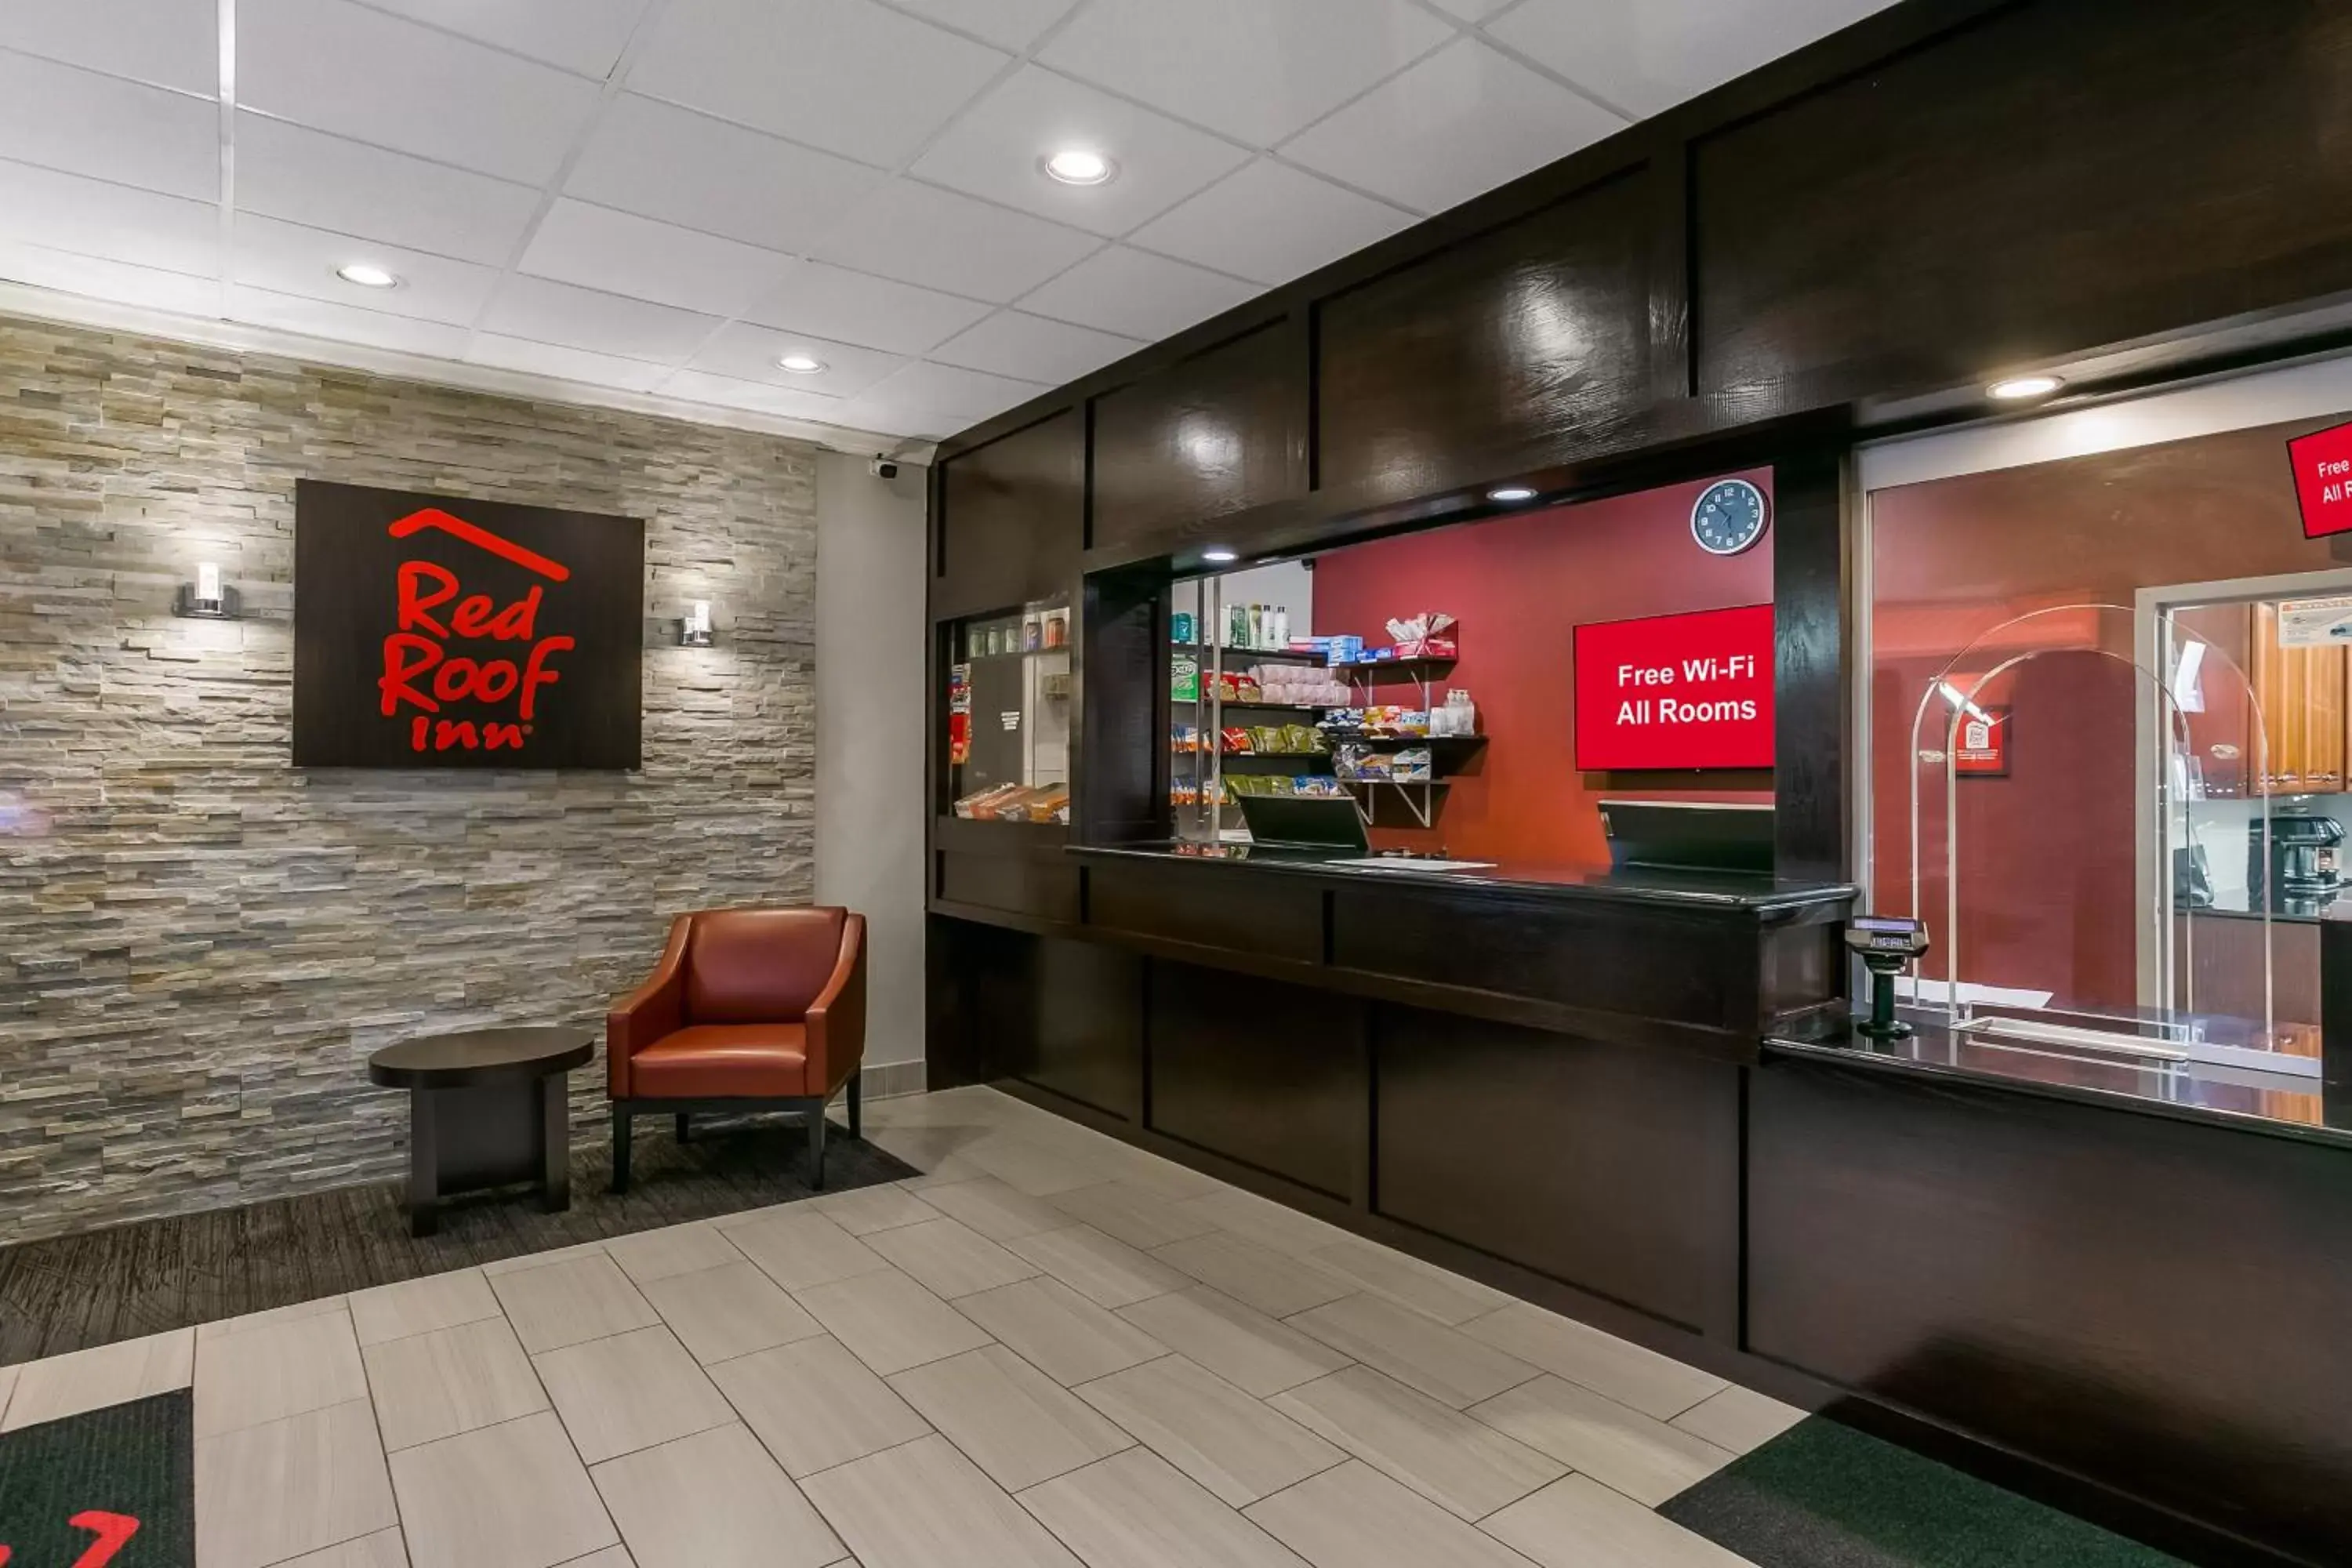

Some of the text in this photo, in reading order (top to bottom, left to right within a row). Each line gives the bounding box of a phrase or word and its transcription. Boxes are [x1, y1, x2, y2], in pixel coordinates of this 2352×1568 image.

[2318, 459, 2350, 478] Free
[1724, 488, 1734, 496] 12
[1741, 489, 1745, 499] 1
[1748, 497, 1755, 506] 2
[2323, 484, 2342, 504] All
[1706, 504, 1715, 513] 10
[1726, 538, 1733, 546] 6
[397, 561, 543, 641] Red
[378, 632, 575, 720] Roof
[1618, 655, 1754, 687] Free Wi-Fi
[1616, 699, 1757, 725] All Rooms
